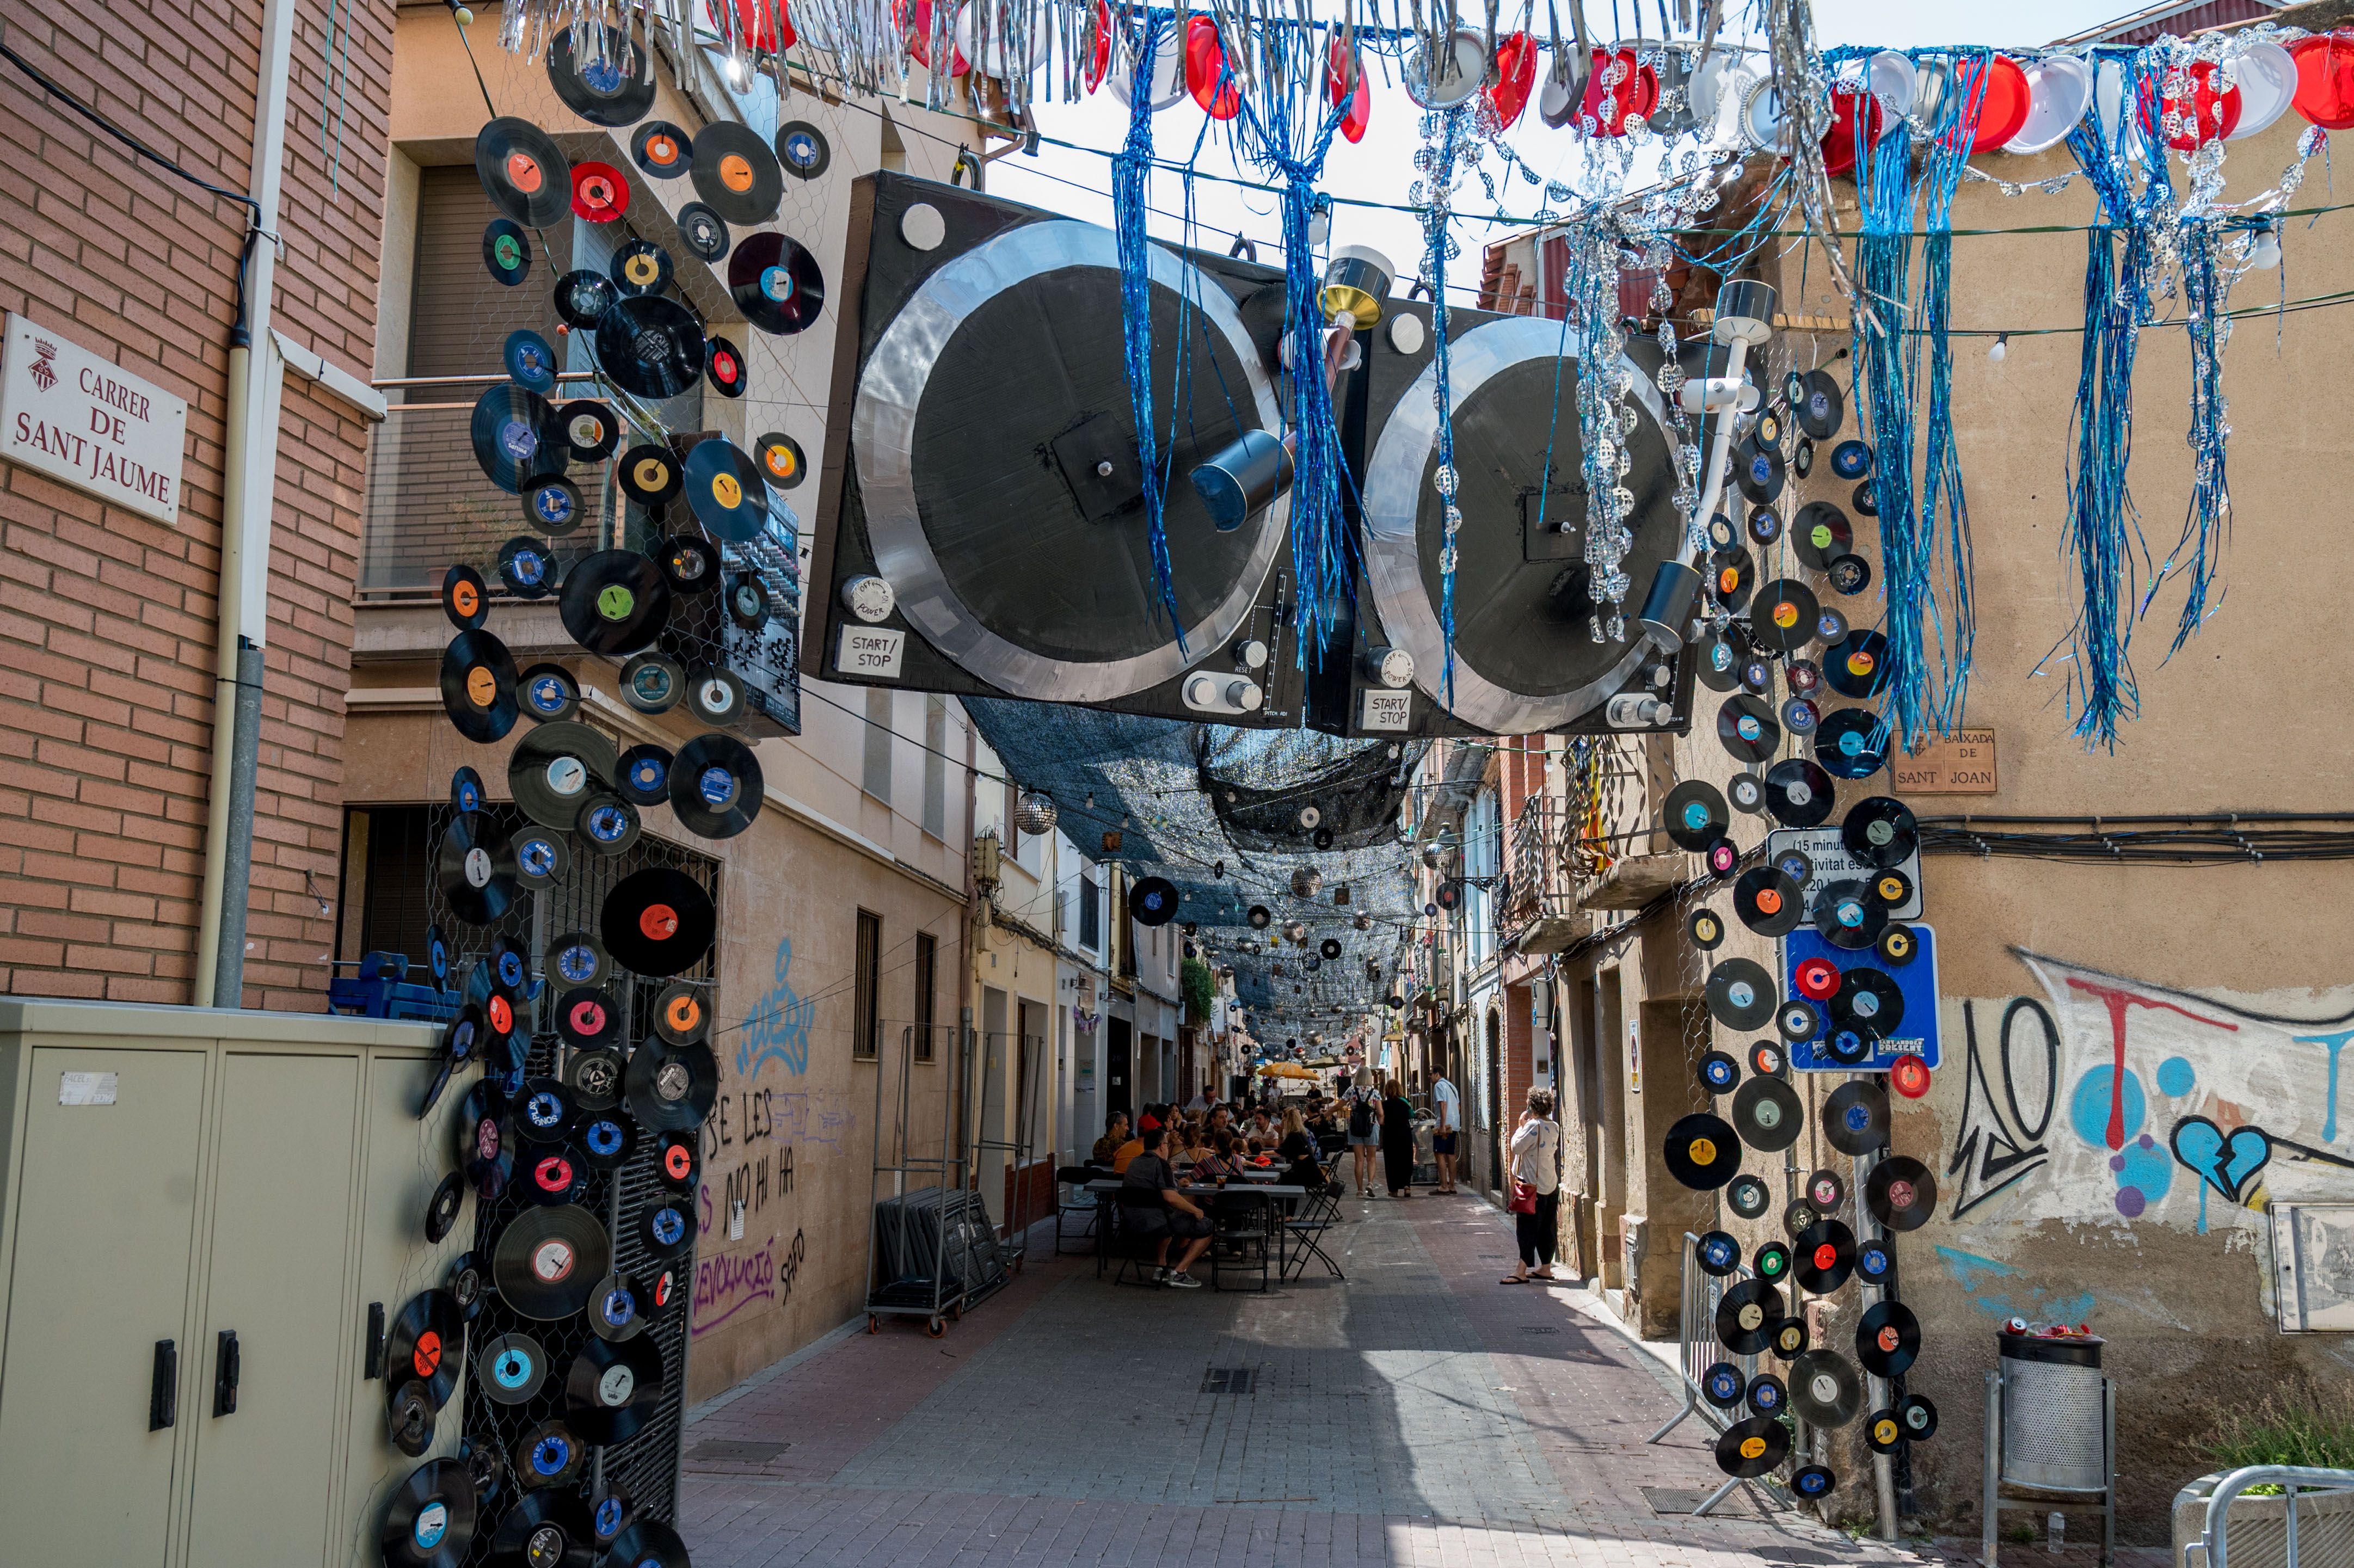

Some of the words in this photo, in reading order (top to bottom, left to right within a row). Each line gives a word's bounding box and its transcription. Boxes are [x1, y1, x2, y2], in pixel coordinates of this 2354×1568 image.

[79, 367, 150, 422] CARRER
[89, 406, 126, 445] DE
[508, 443, 527, 455] PHILIPS
[15, 411, 87, 466] SANT
[90, 445, 170, 504] JAUME
[860, 580, 871, 592] OFF
[882, 595, 889, 604] ON
[857, 603, 884, 616] POWER
[852, 637, 897, 654] START/
[858, 654, 891, 667] STOP
[1385, 653, 1397, 665] OFF
[1384, 670, 1406, 682] POWER
[1372, 697, 1408, 711] START/
[1380, 711, 1407, 724] STOP
[1945, 734, 1994, 743] BAXADA
[1960, 748, 1977, 758] DE
[1898, 772, 1937, 783] SANT
[1951, 772, 1991, 783] JOAN
[1793, 839, 1809, 852] (15
[560, 948, 577, 977] BELTER
[65, 1074, 85, 1083] FACEL
[660, 1067, 674, 1086] PHILIPS
[743, 1087, 772, 1145] LES
[723, 1161, 750, 1235] NO
[755, 1155, 769, 1212] HI
[779, 1146, 794, 1197] HA
[534, 1437, 563, 1458] BELTER
